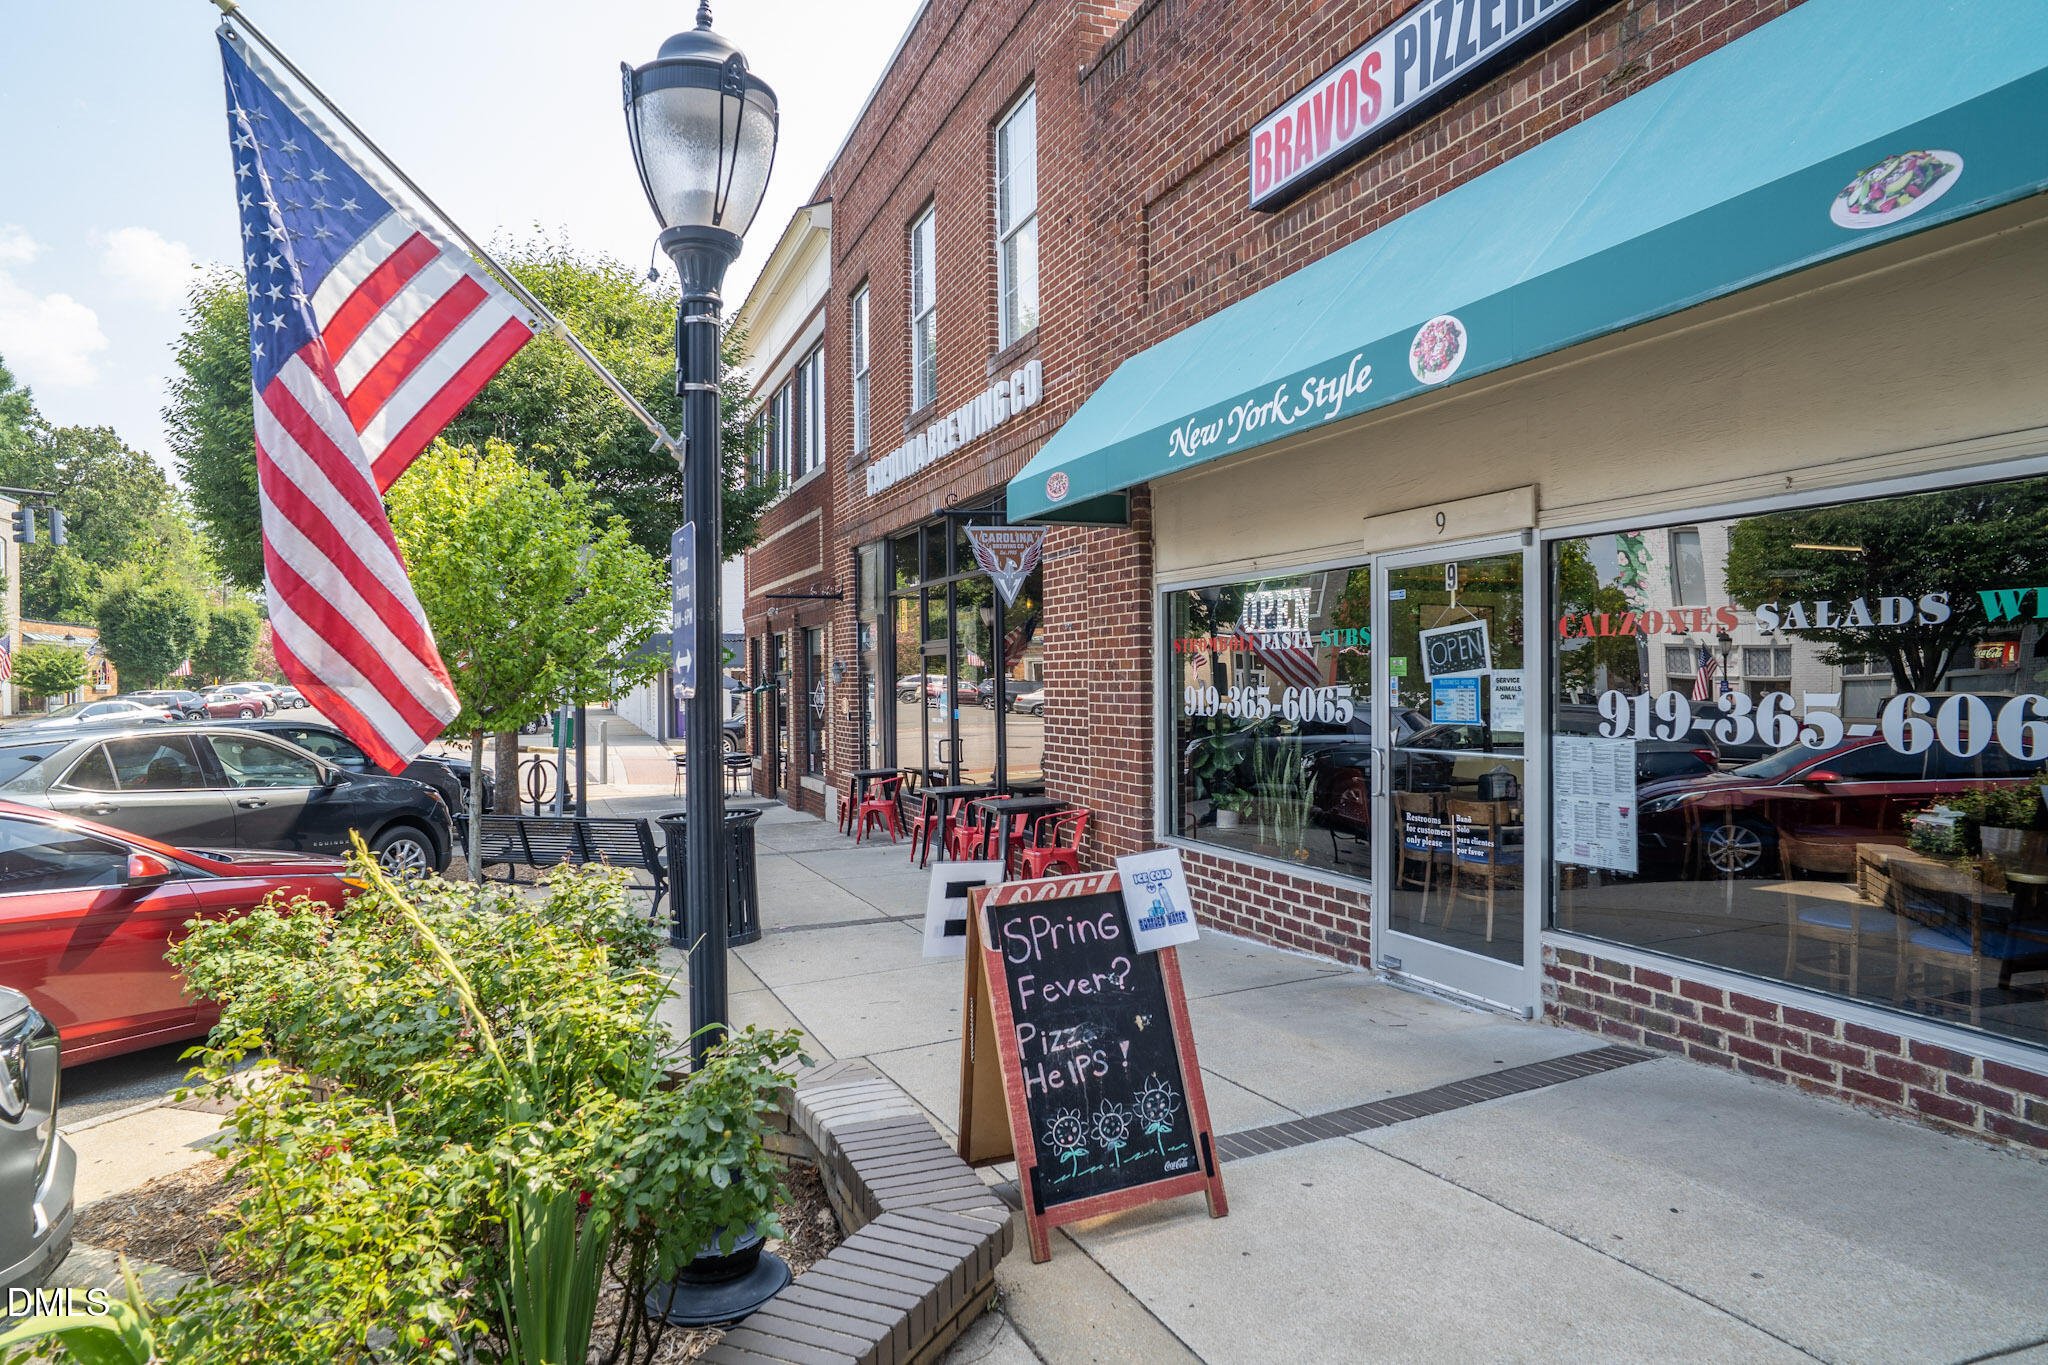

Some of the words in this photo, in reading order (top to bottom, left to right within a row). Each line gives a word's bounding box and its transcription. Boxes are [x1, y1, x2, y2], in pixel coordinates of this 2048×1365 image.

[1254, 51, 1382, 198] BRAVOS
[1393, 0, 1560, 109] PIZZE
[1009, 359, 1044, 417] CO
[1168, 417, 1223, 458] New
[1227, 399, 1295, 445] York
[1294, 353, 1373, 420] Style
[1435, 511, 1446, 535] 9
[981, 532, 1035, 544] CAROLINA
[1447, 563, 1457, 590] 9
[1242, 587, 1312, 633] OPEN
[1559, 605, 1738, 639] CALZONES
[1755, 591, 1951, 632] SALADS
[1173, 635, 1254, 654] STROMBOLI
[1260, 631, 1314, 650] PASTA
[1320, 625, 1371, 648] SUBS
[1430, 631, 1484, 666] OPEN
[1184, 685, 1354, 724] 919-365-6065
[1406, 811, 1442, 825] Restrooms
[1406, 823, 1416, 833] for
[1416, 826, 1451, 837] customers
[1456, 824, 1471, 834] Solo
[1406, 835, 1421, 846] only
[1421, 836, 1443, 848] please
[1132, 872, 1149, 885] ICE
[1149, 868, 1172, 881] COLD
[1018, 956, 1131, 1010] Fever?
